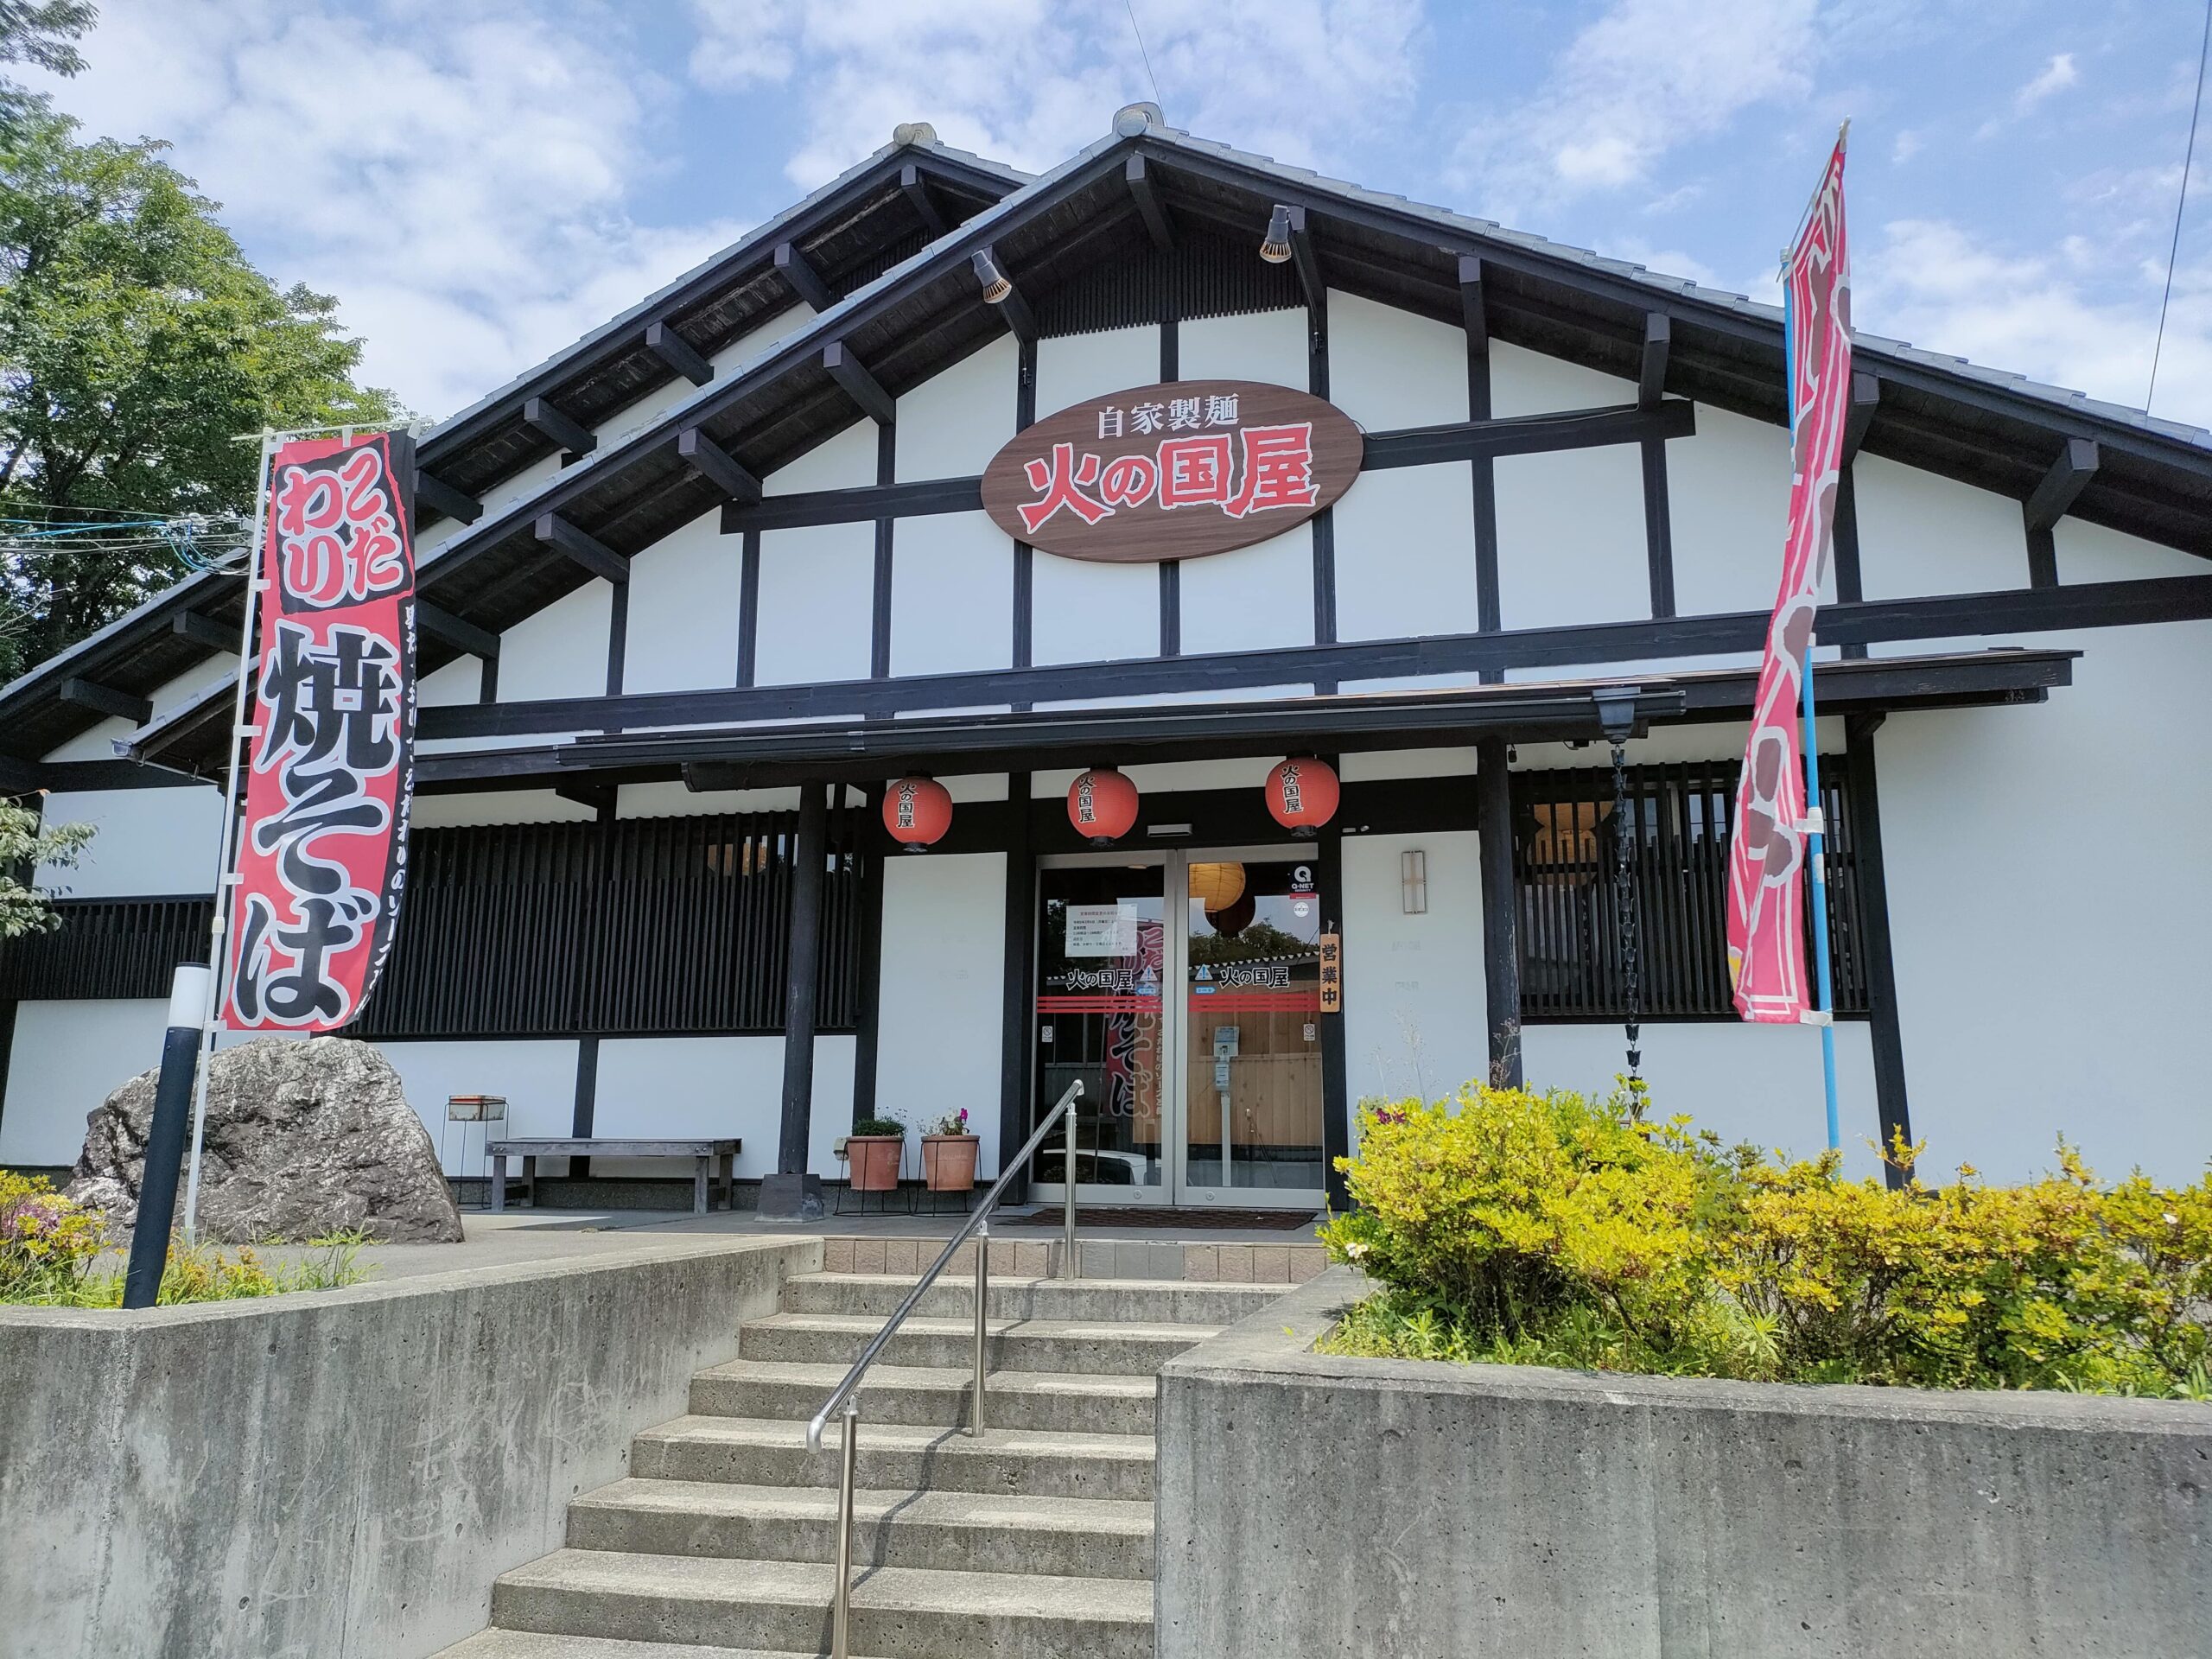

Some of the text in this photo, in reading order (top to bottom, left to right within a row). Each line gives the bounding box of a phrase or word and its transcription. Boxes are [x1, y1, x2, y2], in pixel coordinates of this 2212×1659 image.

[1097, 393, 1240, 439] 自家製麺
[1017, 422, 1321, 534] 火の国屋
[896, 782, 918, 829] 火の国屋
[1078, 776, 1097, 823] 火の国屋
[1281, 764, 1303, 815] 火の国屋
[232, 619, 404, 1027] 焼そば
[1066, 969, 1135, 991] 火の国屋
[1219, 966, 1291, 988] 火の国屋
[1322, 944, 1338, 1005] 営業中
